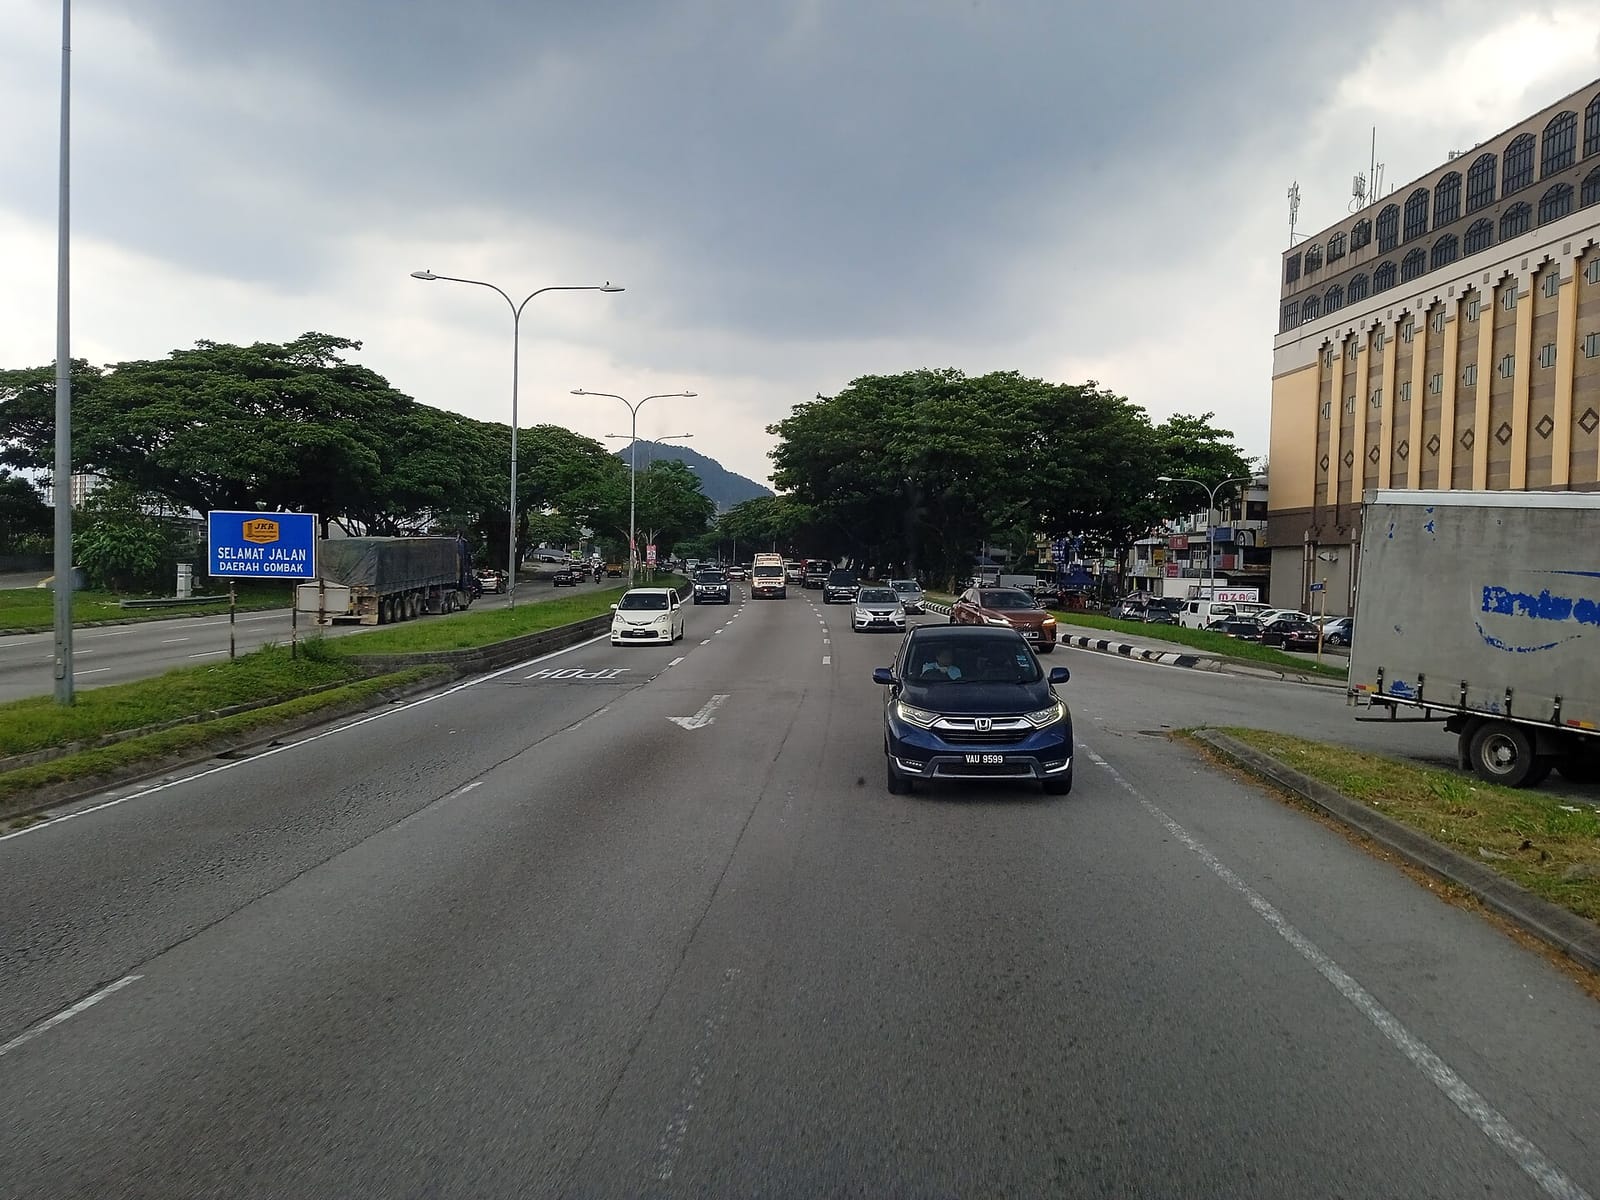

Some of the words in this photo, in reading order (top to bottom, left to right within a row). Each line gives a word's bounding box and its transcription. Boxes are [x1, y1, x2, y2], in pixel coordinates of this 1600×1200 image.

[217, 547, 264, 560] SELAMAT
[268, 549, 306, 561] JALAN
[219, 561, 259, 572] DAERAH
[263, 563, 303, 573] GOMBAK
[524, 668, 631, 679] IPOH
[965, 754, 980, 764] VAU
[982, 754, 1003, 764] 9599
